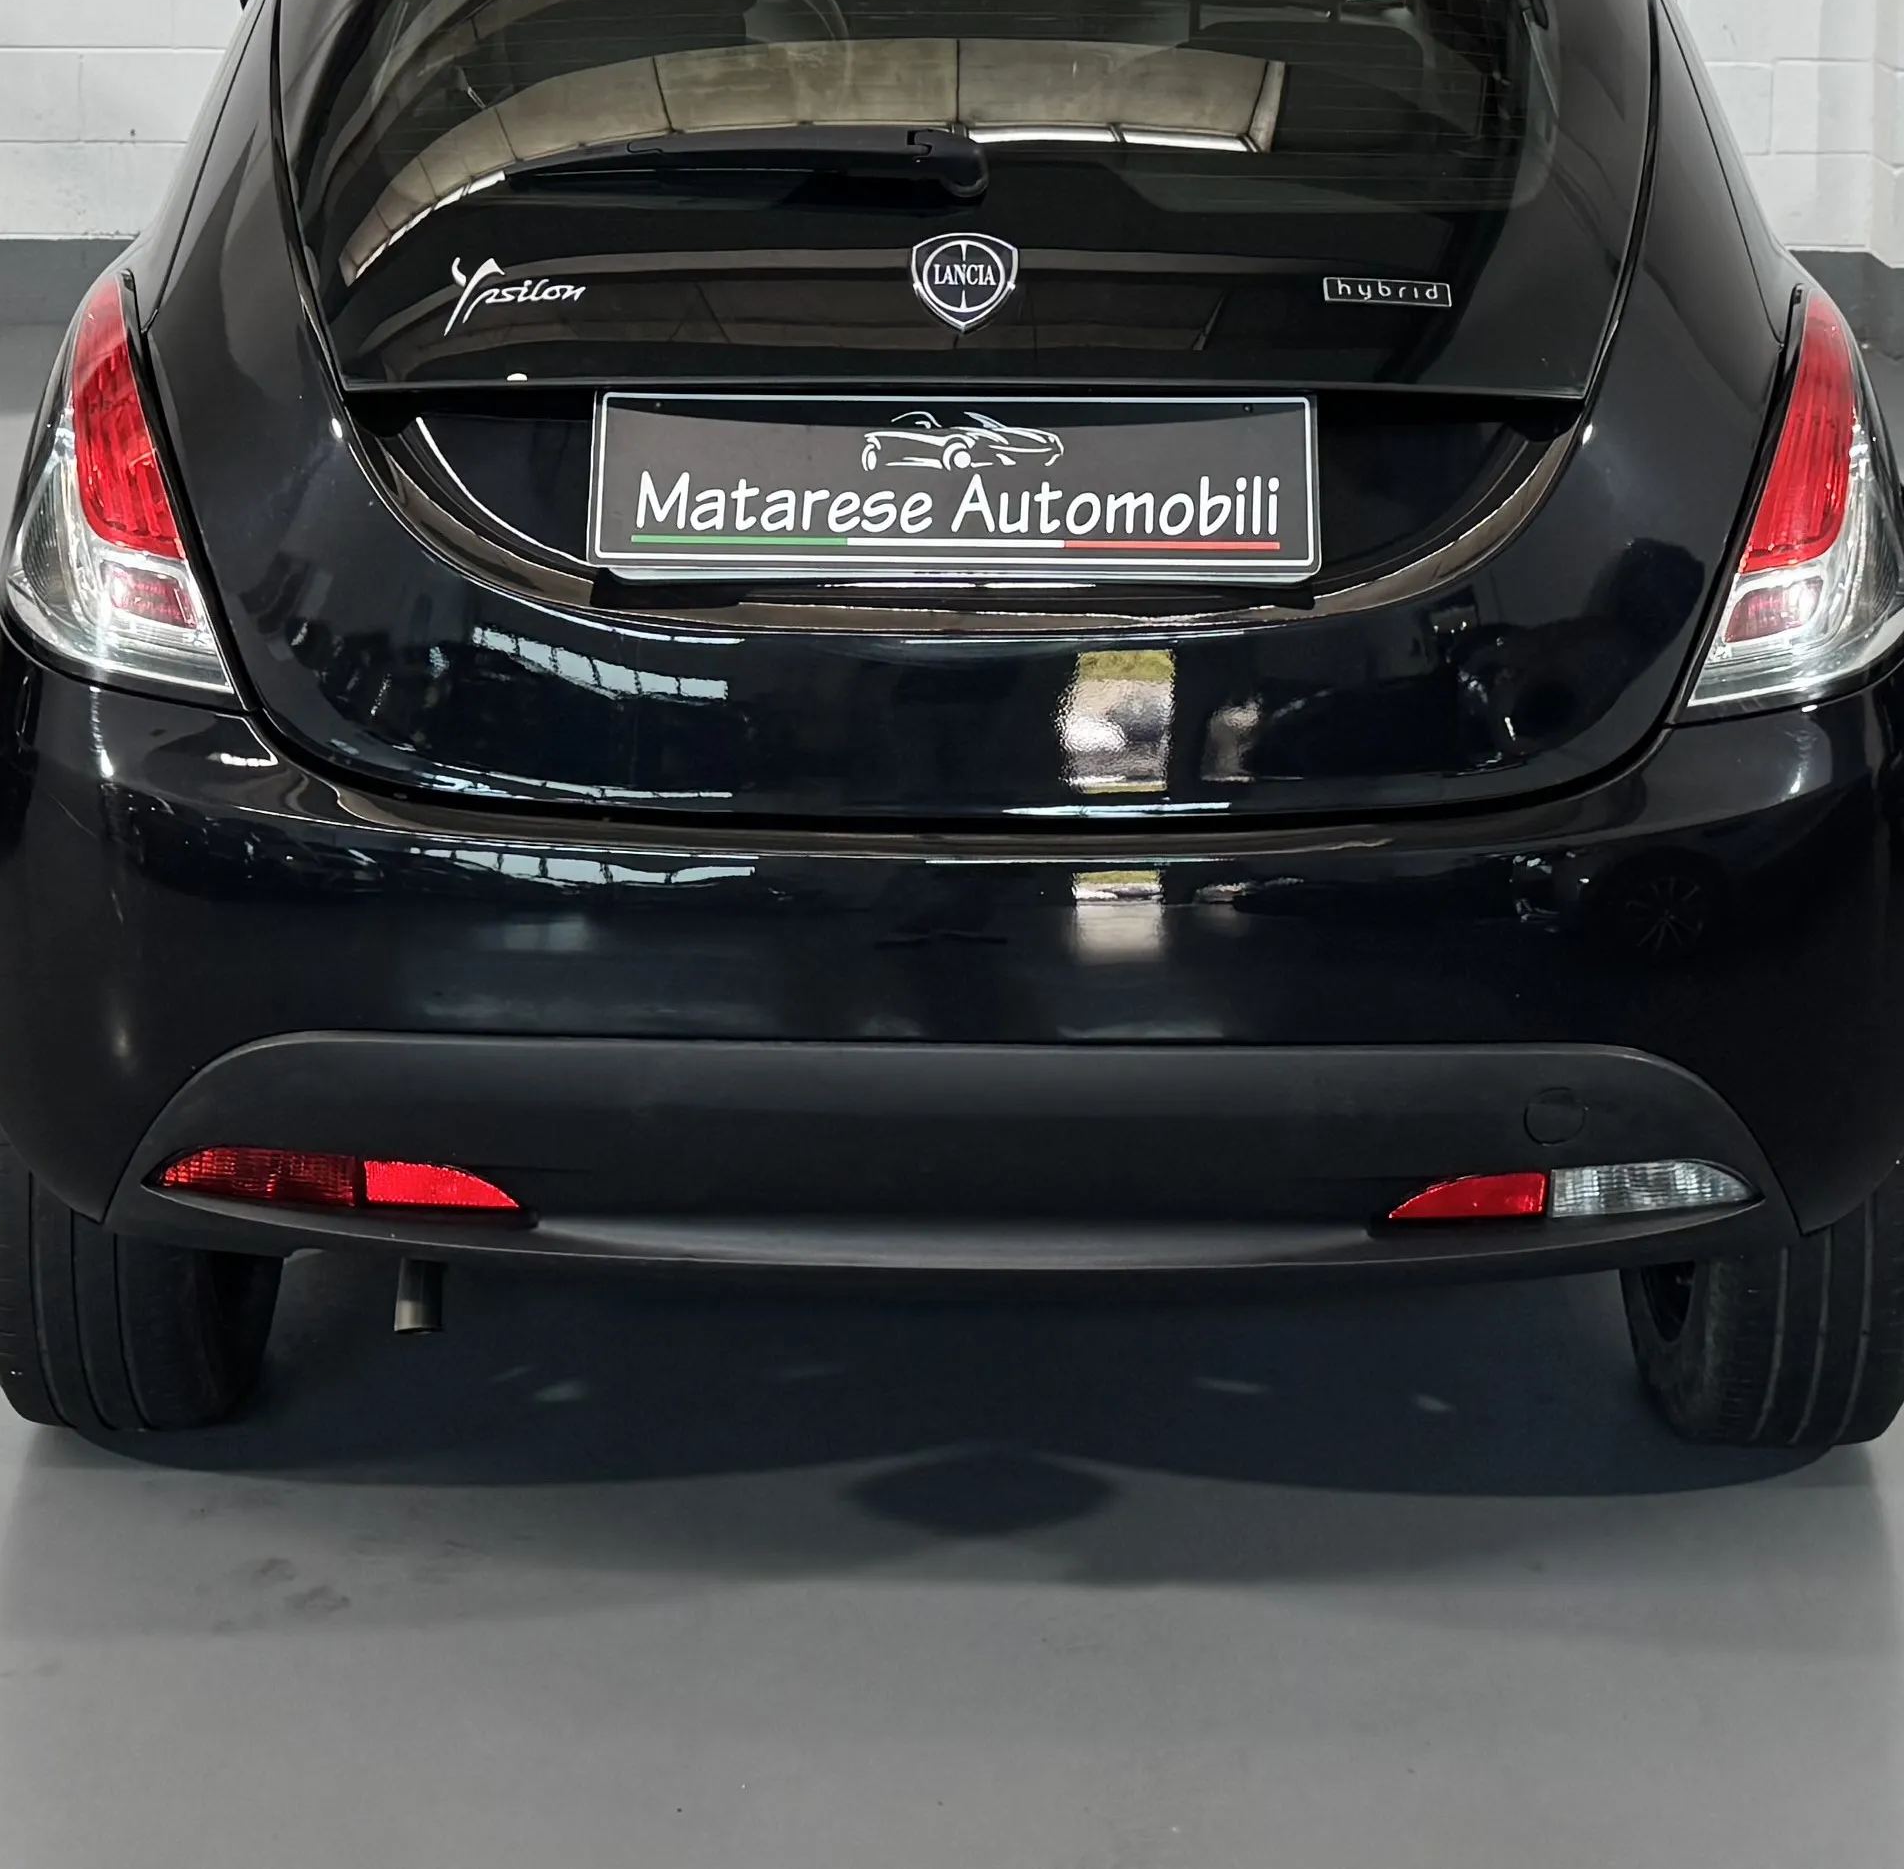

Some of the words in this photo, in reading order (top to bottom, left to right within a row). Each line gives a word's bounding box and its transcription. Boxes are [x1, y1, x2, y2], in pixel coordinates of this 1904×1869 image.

[443, 256, 587, 337] Ypsilon
[933, 263, 997, 286] LANCIA
[1337, 277, 1439, 301] hybrid
[635, 470, 933, 534] Matarese
[950, 472, 1280, 537] Automobili
